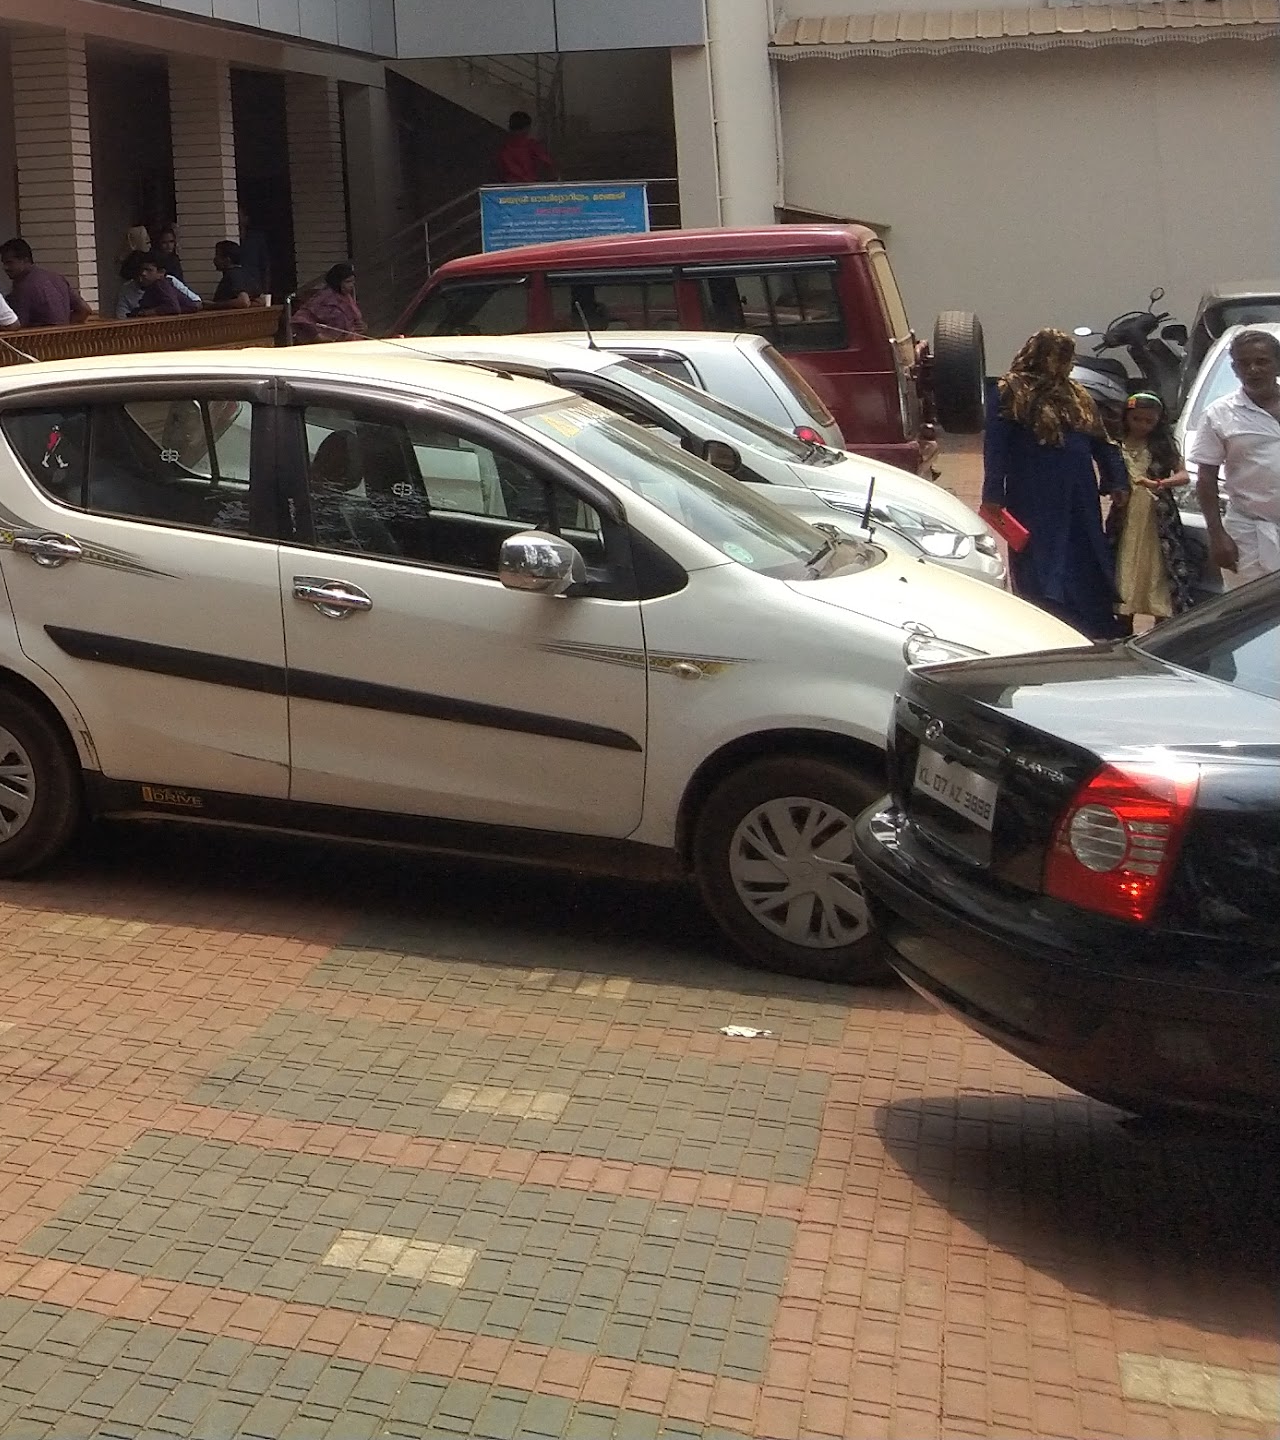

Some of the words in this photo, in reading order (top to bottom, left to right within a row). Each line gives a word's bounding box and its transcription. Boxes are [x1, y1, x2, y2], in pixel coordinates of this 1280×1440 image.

[919, 767, 931, 786] KL
[933, 773, 948, 794] 07
[153, 791, 203, 806] DRIVE
